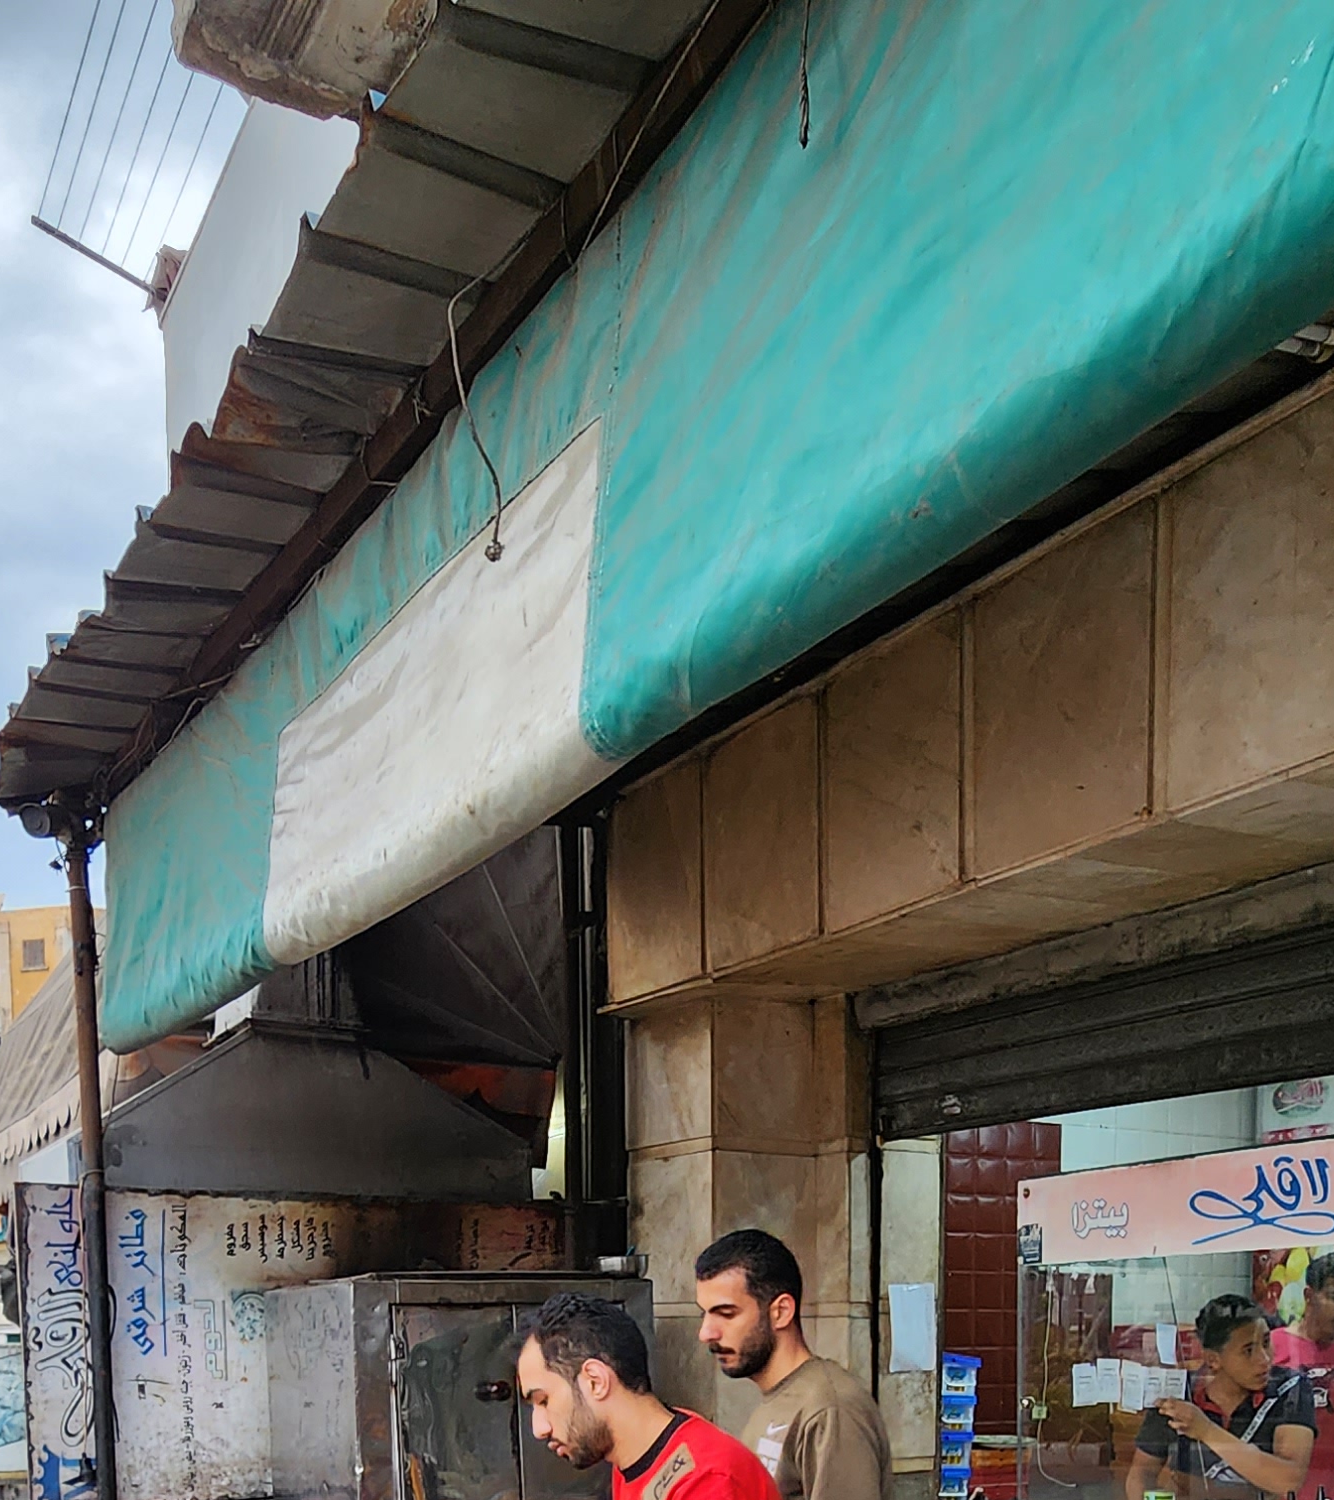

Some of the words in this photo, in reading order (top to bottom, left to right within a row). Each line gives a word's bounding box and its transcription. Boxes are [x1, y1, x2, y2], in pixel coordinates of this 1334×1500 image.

[119, 1209, 156, 1276] فطائر
[1072, 1198, 1129, 1239] بيتزا
[127, 1287, 157, 1356] شرقى
[193, 1299, 224, 1381] لحوم
